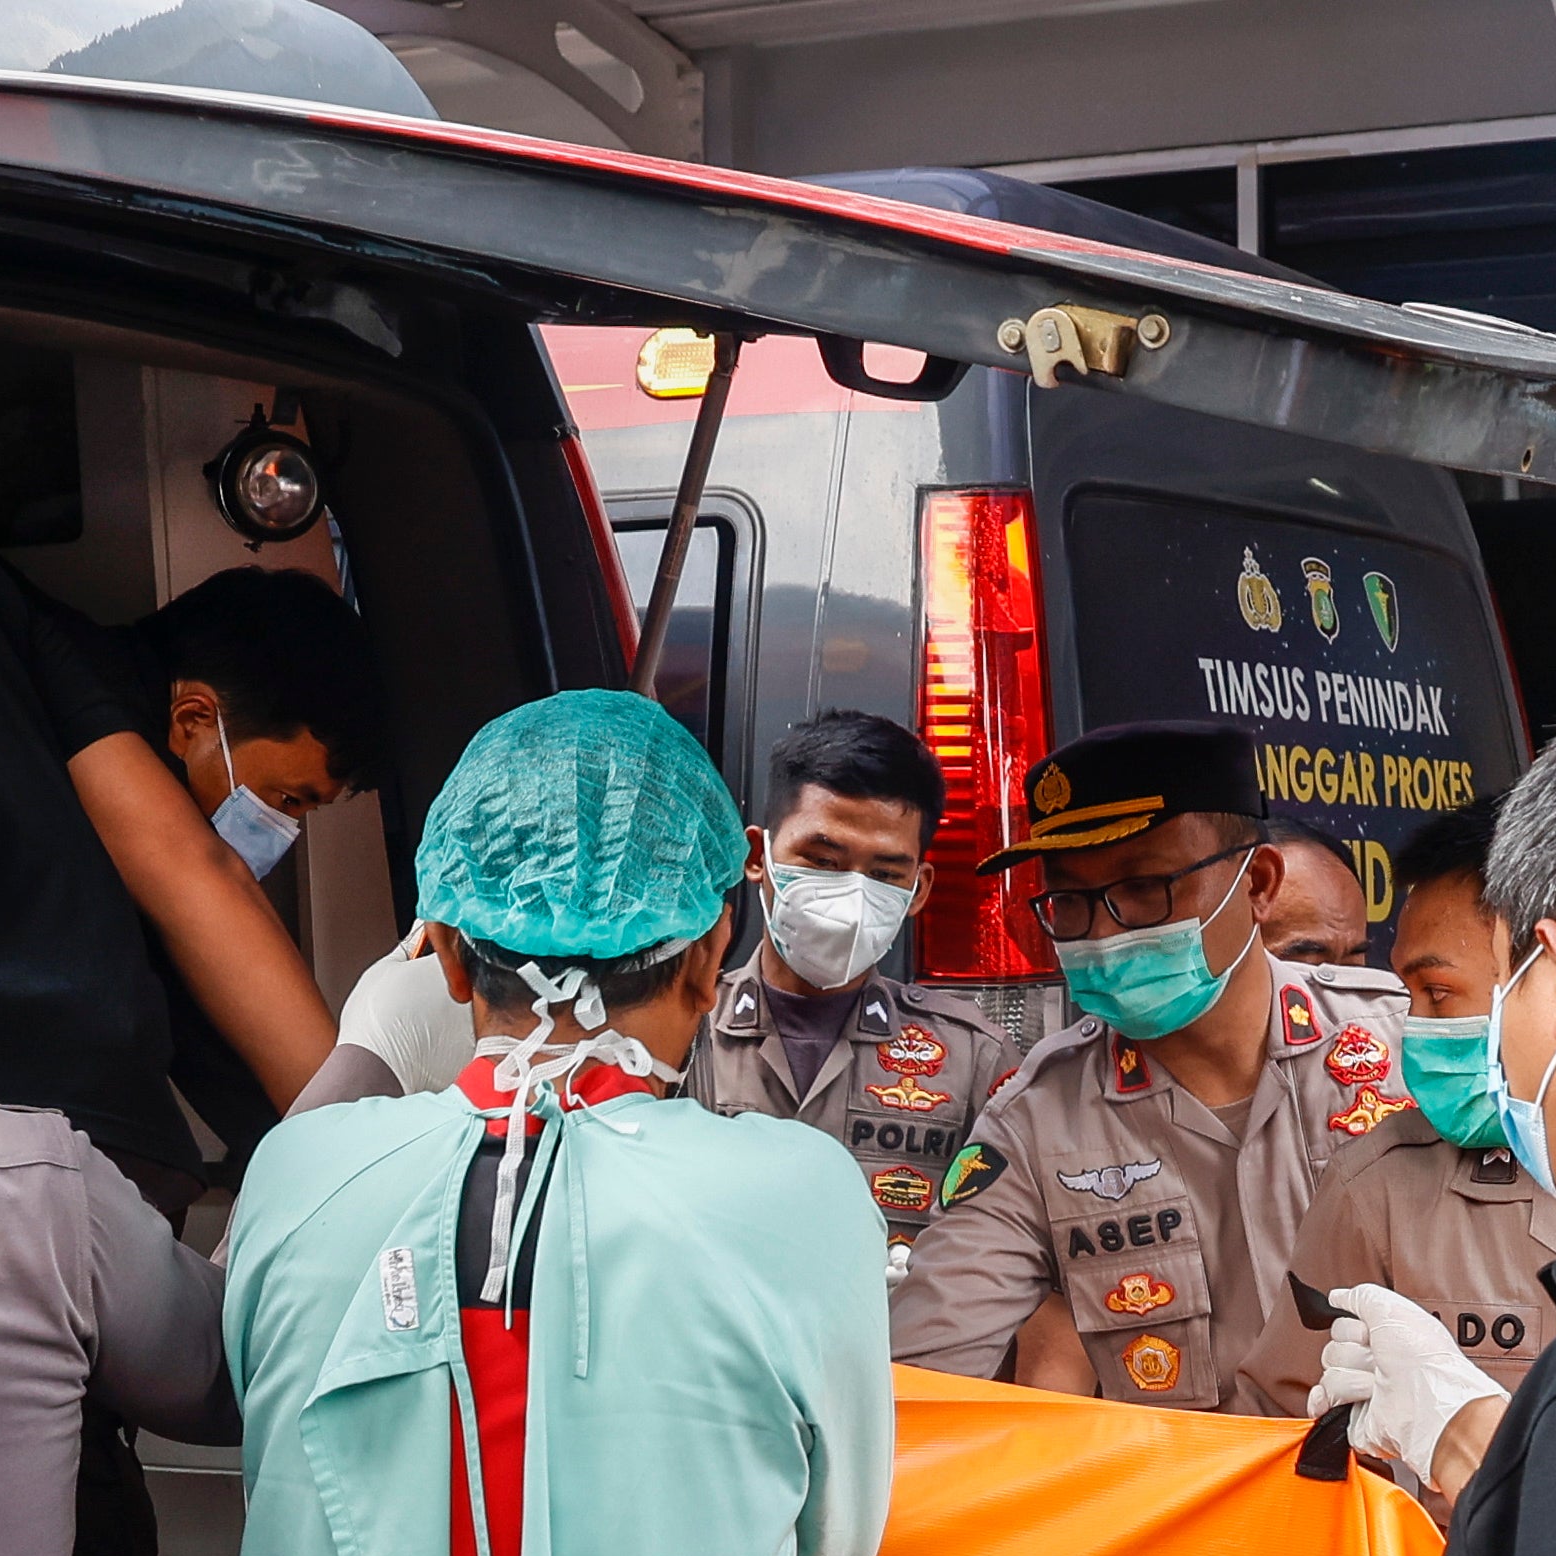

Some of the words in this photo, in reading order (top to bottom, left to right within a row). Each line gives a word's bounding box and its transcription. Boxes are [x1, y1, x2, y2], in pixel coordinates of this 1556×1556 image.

[1198, 657, 1311, 722] TIMSUS
[1315, 670, 1450, 737] PENINDAK
[1382, 754, 1476, 811] PROKES
[850, 1118, 957, 1157] POLRI
[1068, 1208, 1182, 1259] ASEP
[1432, 1310, 1526, 1350] DO
